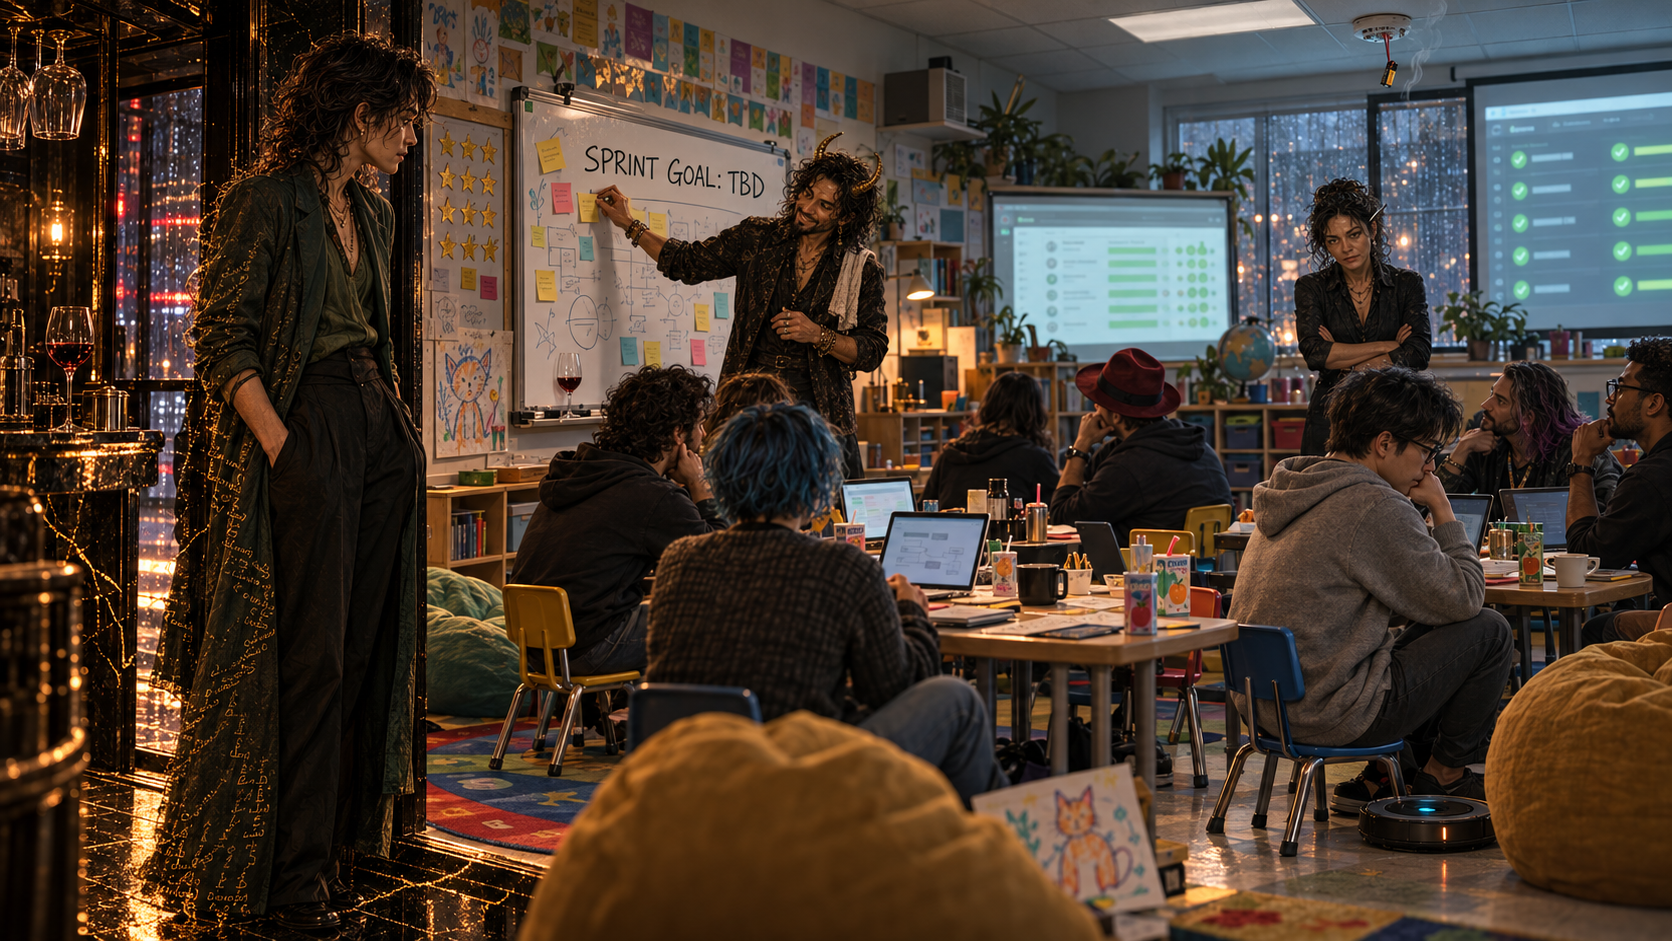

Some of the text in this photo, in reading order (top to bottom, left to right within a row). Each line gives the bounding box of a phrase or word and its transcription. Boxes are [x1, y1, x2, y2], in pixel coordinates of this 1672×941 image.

[585, 146, 659, 180] SPRINT
[668, 158, 721, 189] GOAL:
[728, 170, 765, 198] TBD
